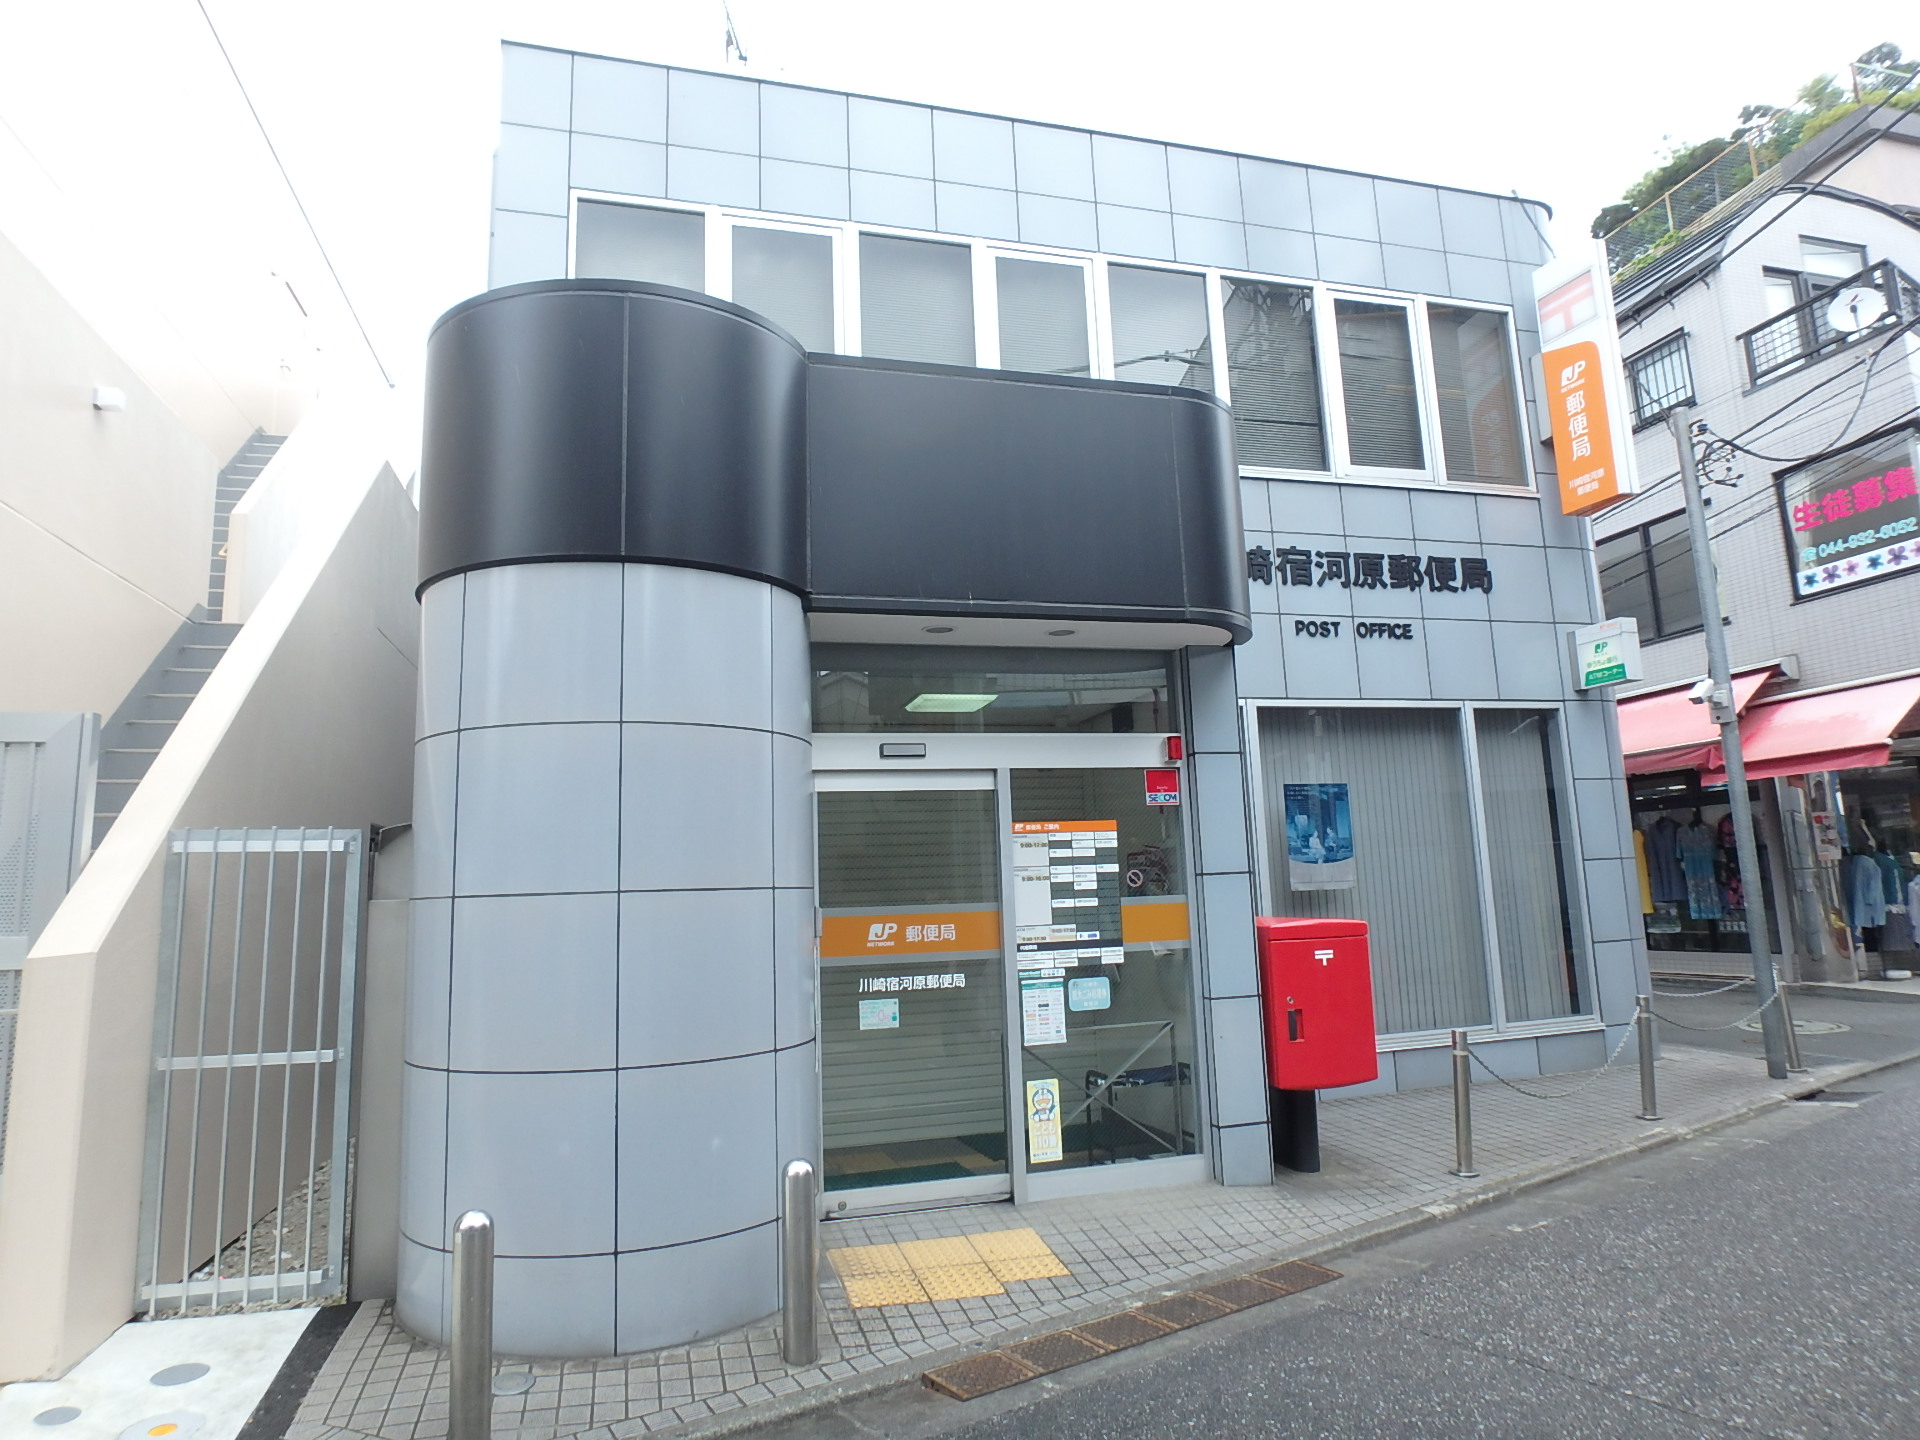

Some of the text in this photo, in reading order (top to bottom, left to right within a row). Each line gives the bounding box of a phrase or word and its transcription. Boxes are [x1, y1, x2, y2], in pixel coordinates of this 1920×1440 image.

[1565, 390, 1591, 461] 郵便局
[1793, 466, 1919, 532] 生徒募集
[1294, 619, 1414, 640] POST OFFICE
[1148, 793, 1177, 802] SECOM
[905, 923, 956, 942] 郵便局
[858, 973, 966, 993] 川崎宿河原郵便局
